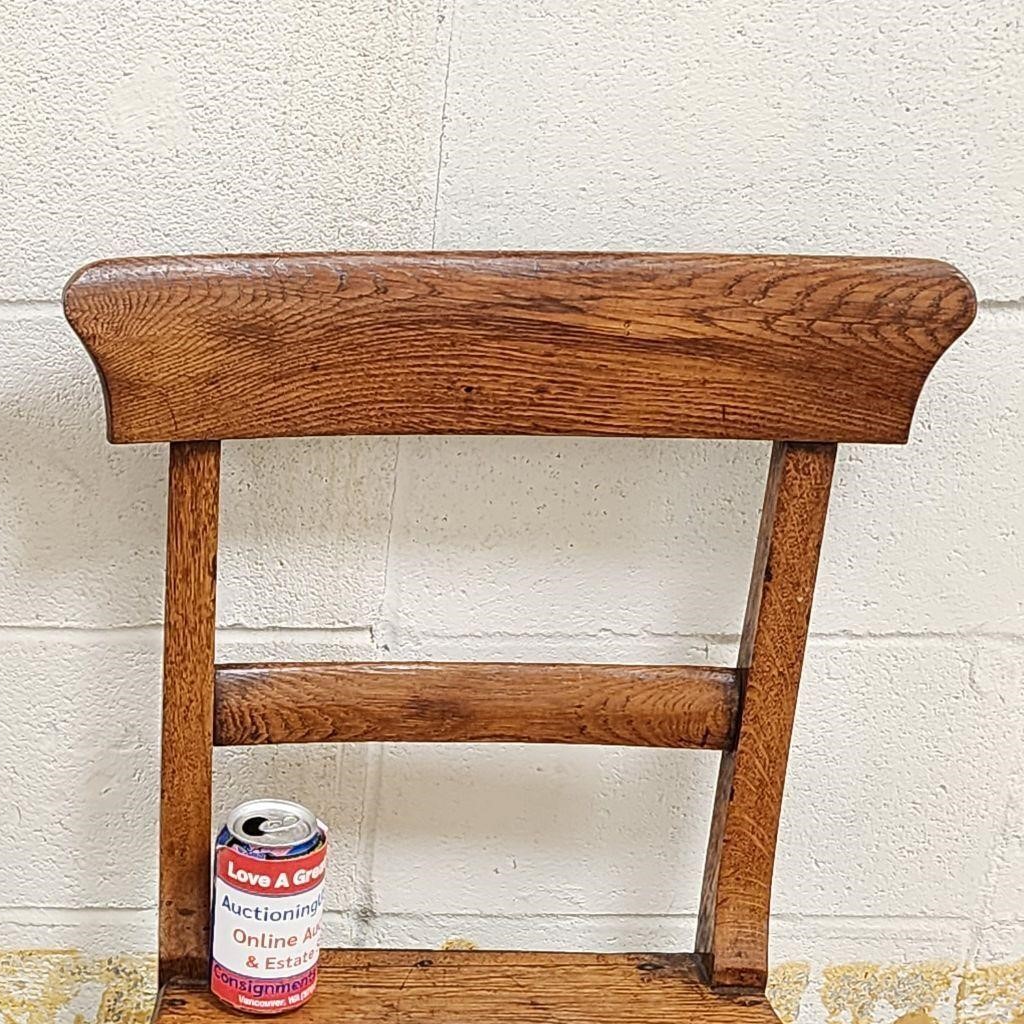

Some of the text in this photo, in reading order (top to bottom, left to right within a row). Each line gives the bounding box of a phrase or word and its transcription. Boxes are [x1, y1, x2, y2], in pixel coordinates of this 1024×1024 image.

[227, 861, 271, 887] Love
[275, 873, 290, 888] A
[233, 928, 297, 948] Online
[246, 948, 315, 970] & Estate
